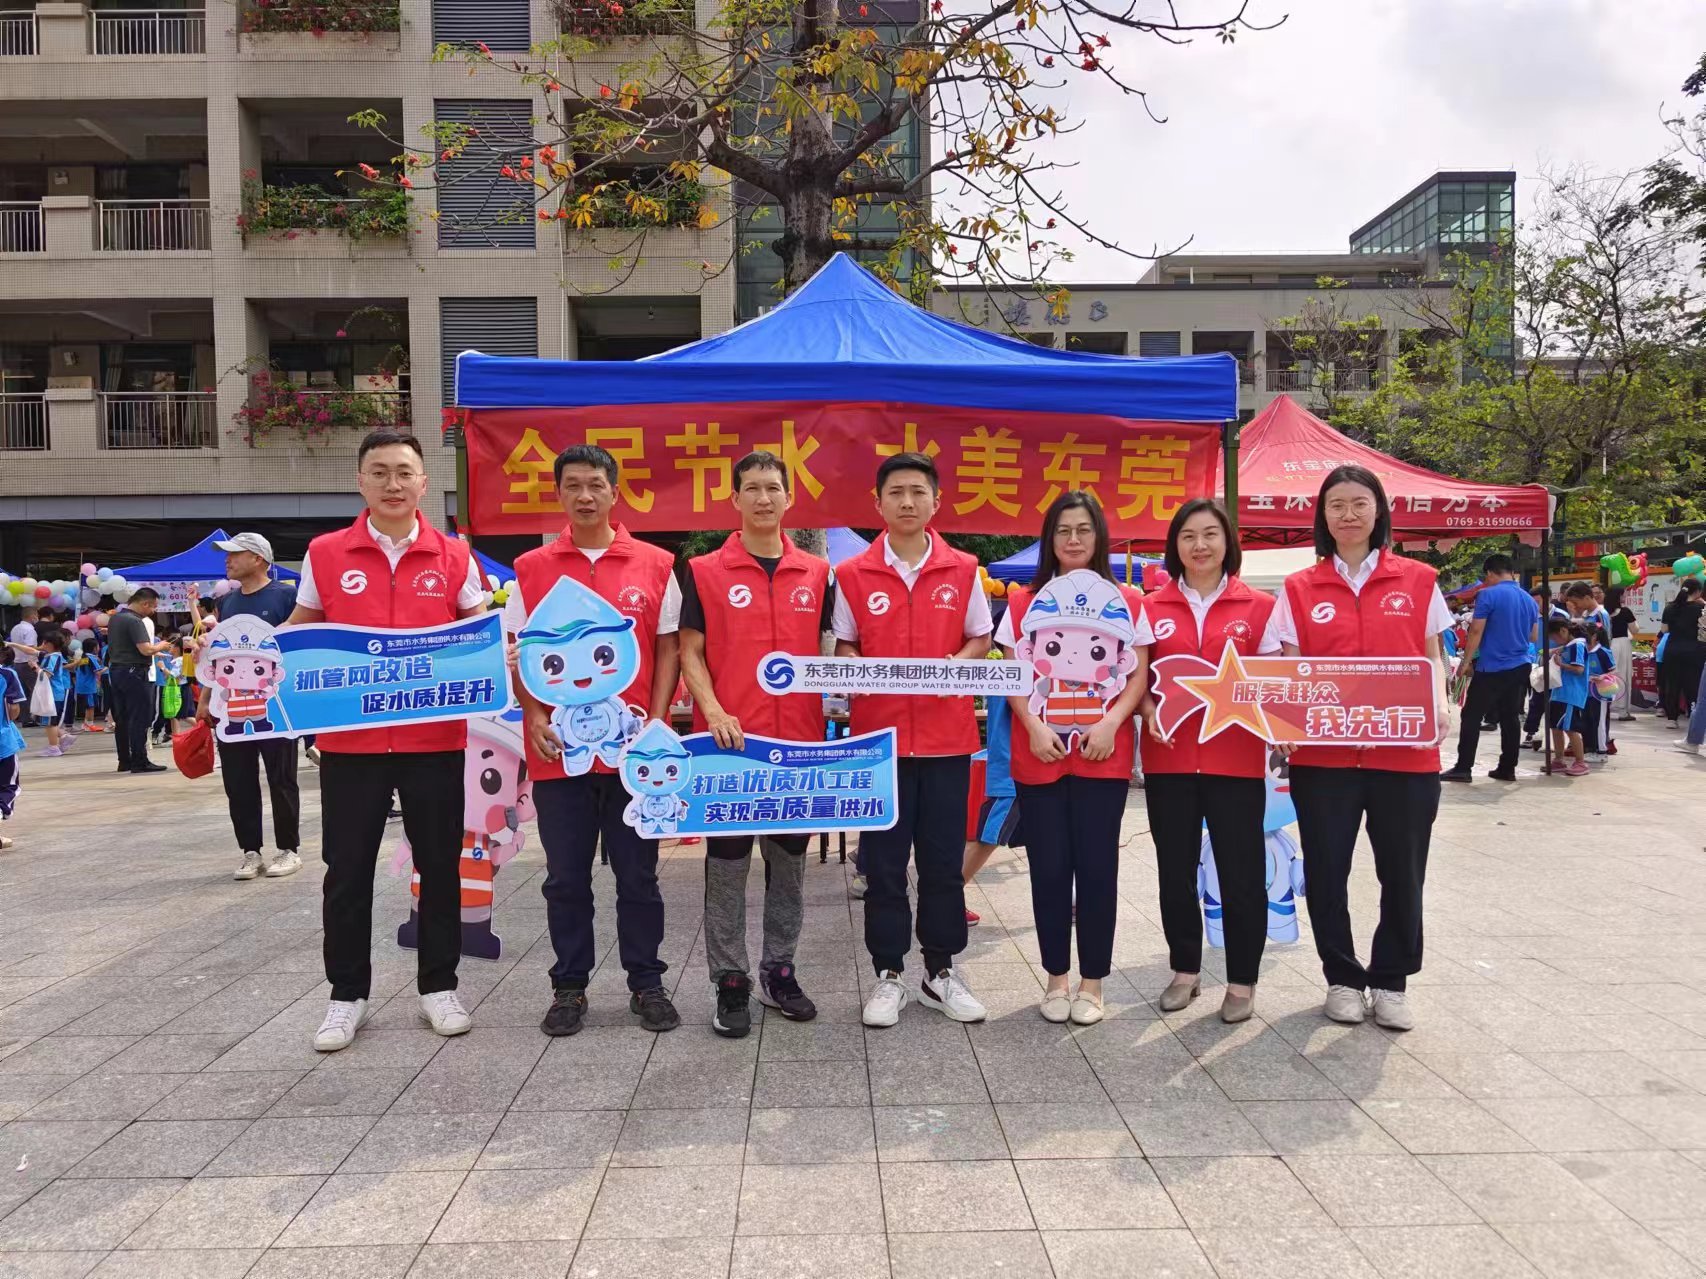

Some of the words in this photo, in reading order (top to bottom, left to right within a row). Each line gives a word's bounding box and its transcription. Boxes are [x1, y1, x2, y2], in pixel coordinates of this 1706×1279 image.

[501, 420, 825, 514] 全民节水
[1446, 516, 1533, 527] 0769-81690666
[386, 631, 491, 649] 东莞市水务集团供水有限公司
[294, 655, 435, 693] 抓管网改造
[804, 663, 1022, 681] 东莞市水务集团供水有限公司
[1315, 664, 1420, 672] 东莞市水务集团供水有限公司
[360, 678, 496, 715] 促水质提升
[1231, 681, 1340, 704] 服务群众
[1305, 705, 1427, 739] 我先行
[786, 748, 883, 759] 东莞市水务集团供水有限公司
[692, 767, 874, 796] 打造优质水工程
[703, 794, 885, 824] 实现高质量供水
